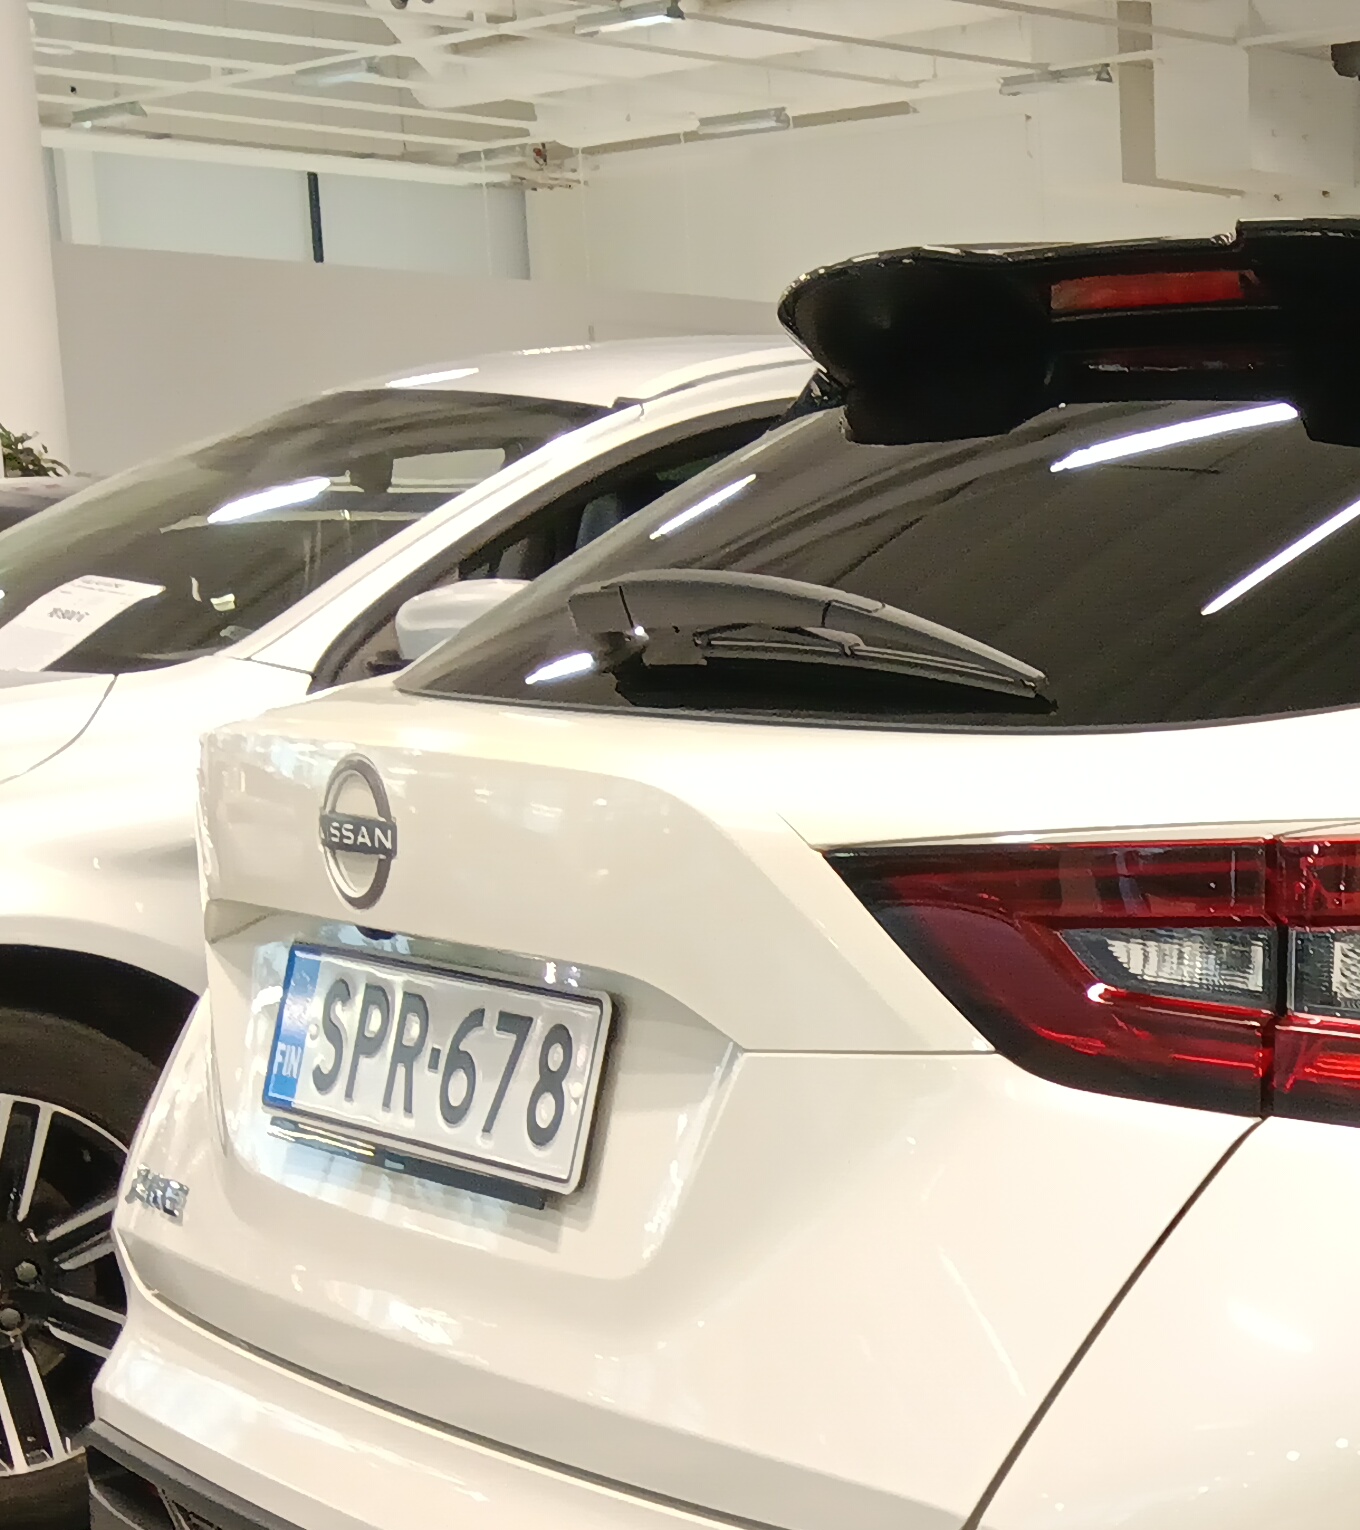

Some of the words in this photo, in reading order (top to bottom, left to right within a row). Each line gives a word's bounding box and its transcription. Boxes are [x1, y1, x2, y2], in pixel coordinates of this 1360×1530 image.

[321, 820, 393, 850] SSAN
[274, 1040, 303, 1079] FIN
[312, 977, 573, 1149] SPR-678
